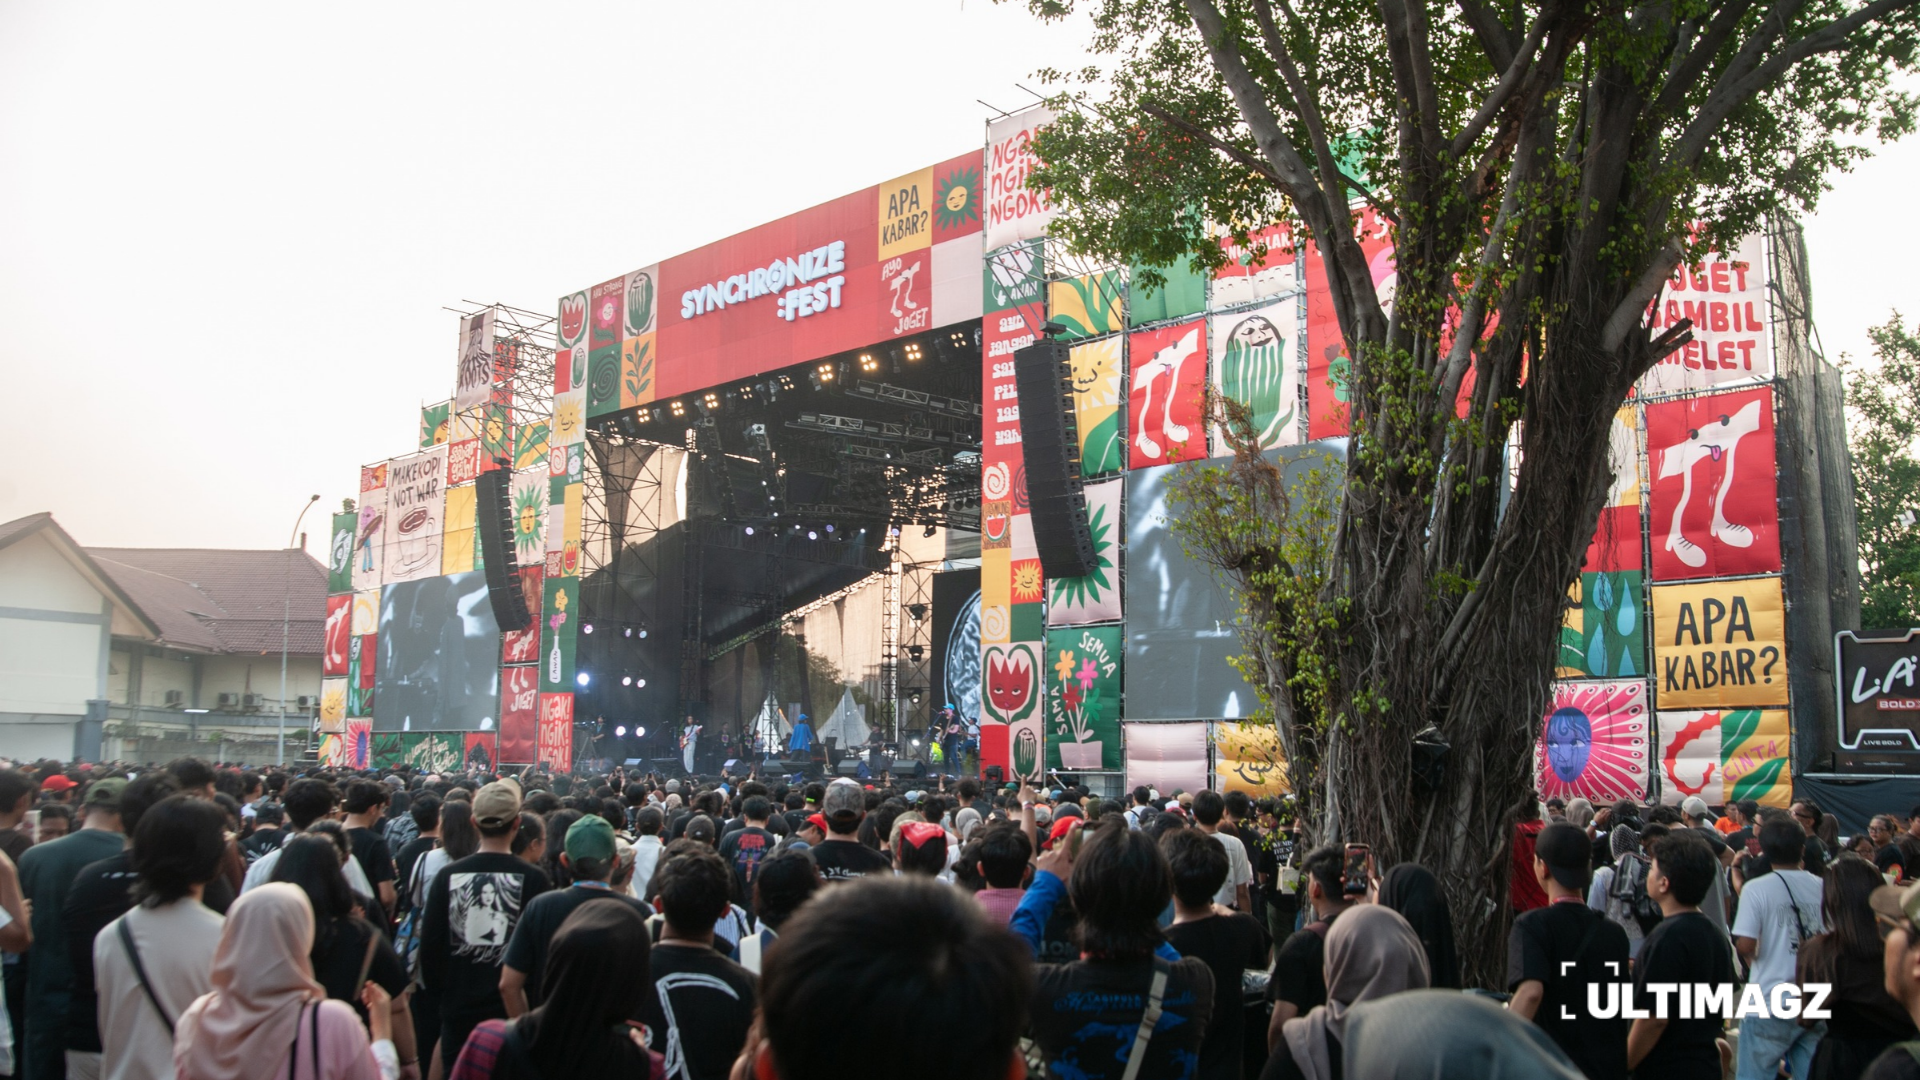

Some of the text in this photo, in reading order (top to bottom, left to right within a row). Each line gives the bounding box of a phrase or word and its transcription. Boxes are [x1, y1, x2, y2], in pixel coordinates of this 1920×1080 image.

[888, 185, 920, 219] APA
[990, 186, 1050, 229] NGOK!
[882, 211, 928, 246] KABAR?
[681, 240, 845, 319] SYNCHRONIZE
[893, 307, 929, 334] JOGET
[393, 478, 438, 509] NOT WAR
[1675, 596, 1754, 646] APA
[1078, 631, 1117, 679] SEMUA
[1665, 646, 1780, 692] KABAR?
[510, 689, 537, 712] JOGET
[1052, 685, 1068, 736] SAMA
[1879, 700, 1916, 709] BOLD
